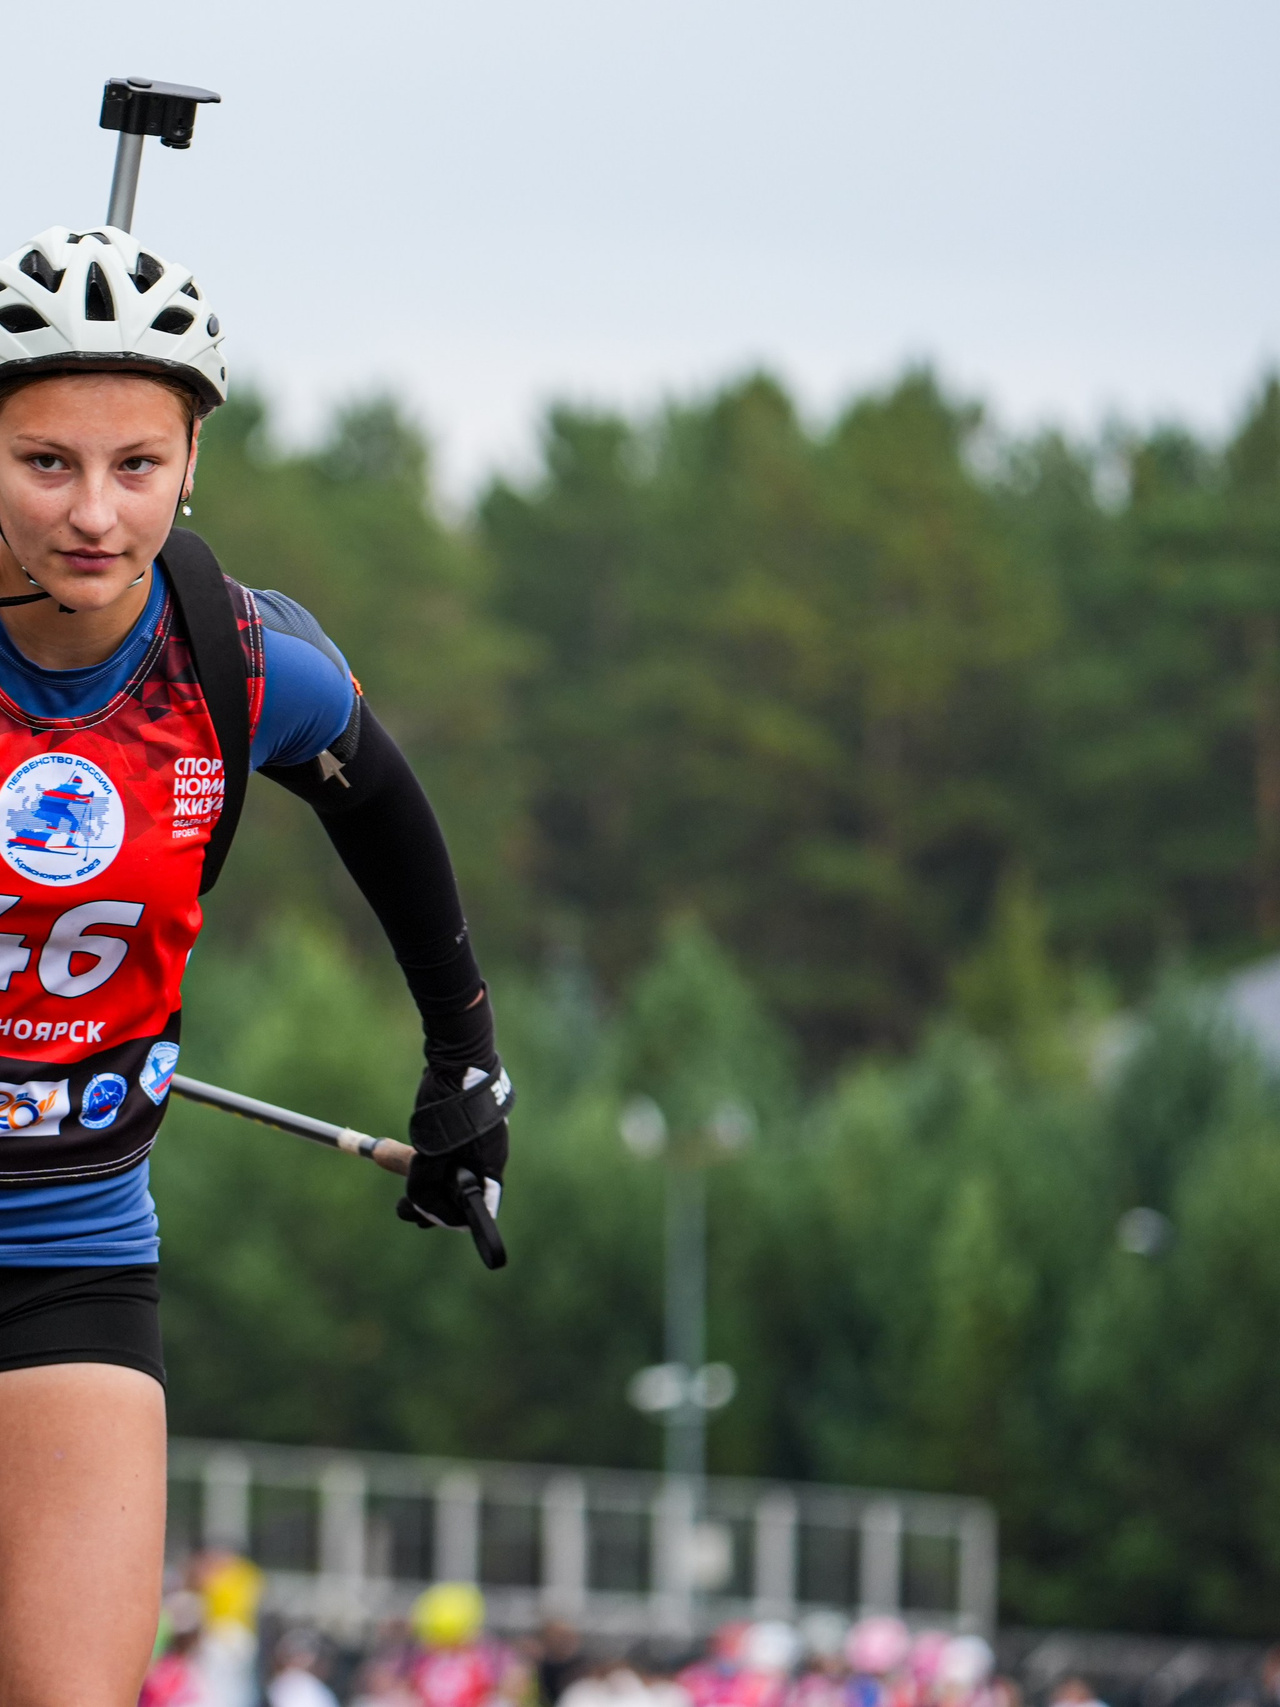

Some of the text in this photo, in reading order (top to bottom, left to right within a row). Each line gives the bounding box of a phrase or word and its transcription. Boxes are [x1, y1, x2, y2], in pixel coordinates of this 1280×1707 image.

[6, 755, 113, 795] ПЕРВЕНСТВО РОССИИ
[174, 757, 225, 776] СПОР
[173, 777, 225, 796] НОРМ
[172, 827, 199, 839] ПРОЕКТ
[14, 857, 72, 881] Красноярск
[75, 858, 101, 877] 2023
